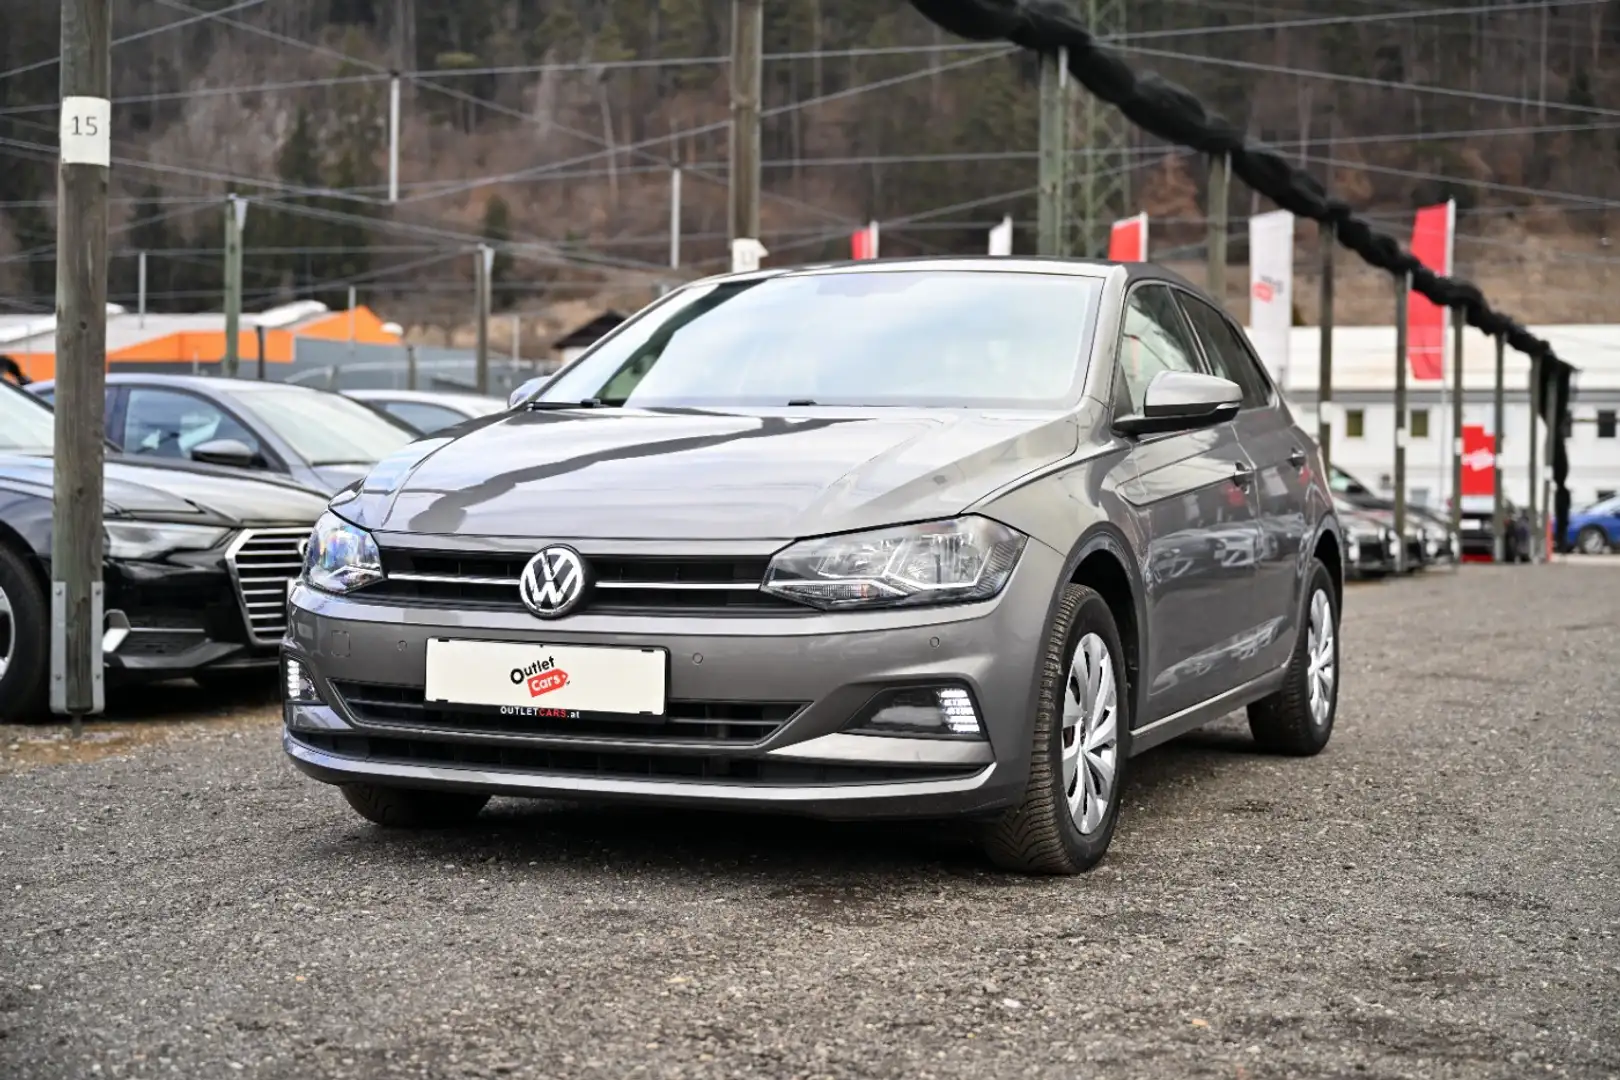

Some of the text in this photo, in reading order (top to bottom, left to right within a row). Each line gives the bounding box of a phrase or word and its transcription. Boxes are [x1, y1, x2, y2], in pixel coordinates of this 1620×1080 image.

[71, 115, 98, 136] 15
[510, 655, 555, 685] Outlet
[531, 674, 561, 691] Cars
[500, 705, 580, 719] OUTLETCARS.at
